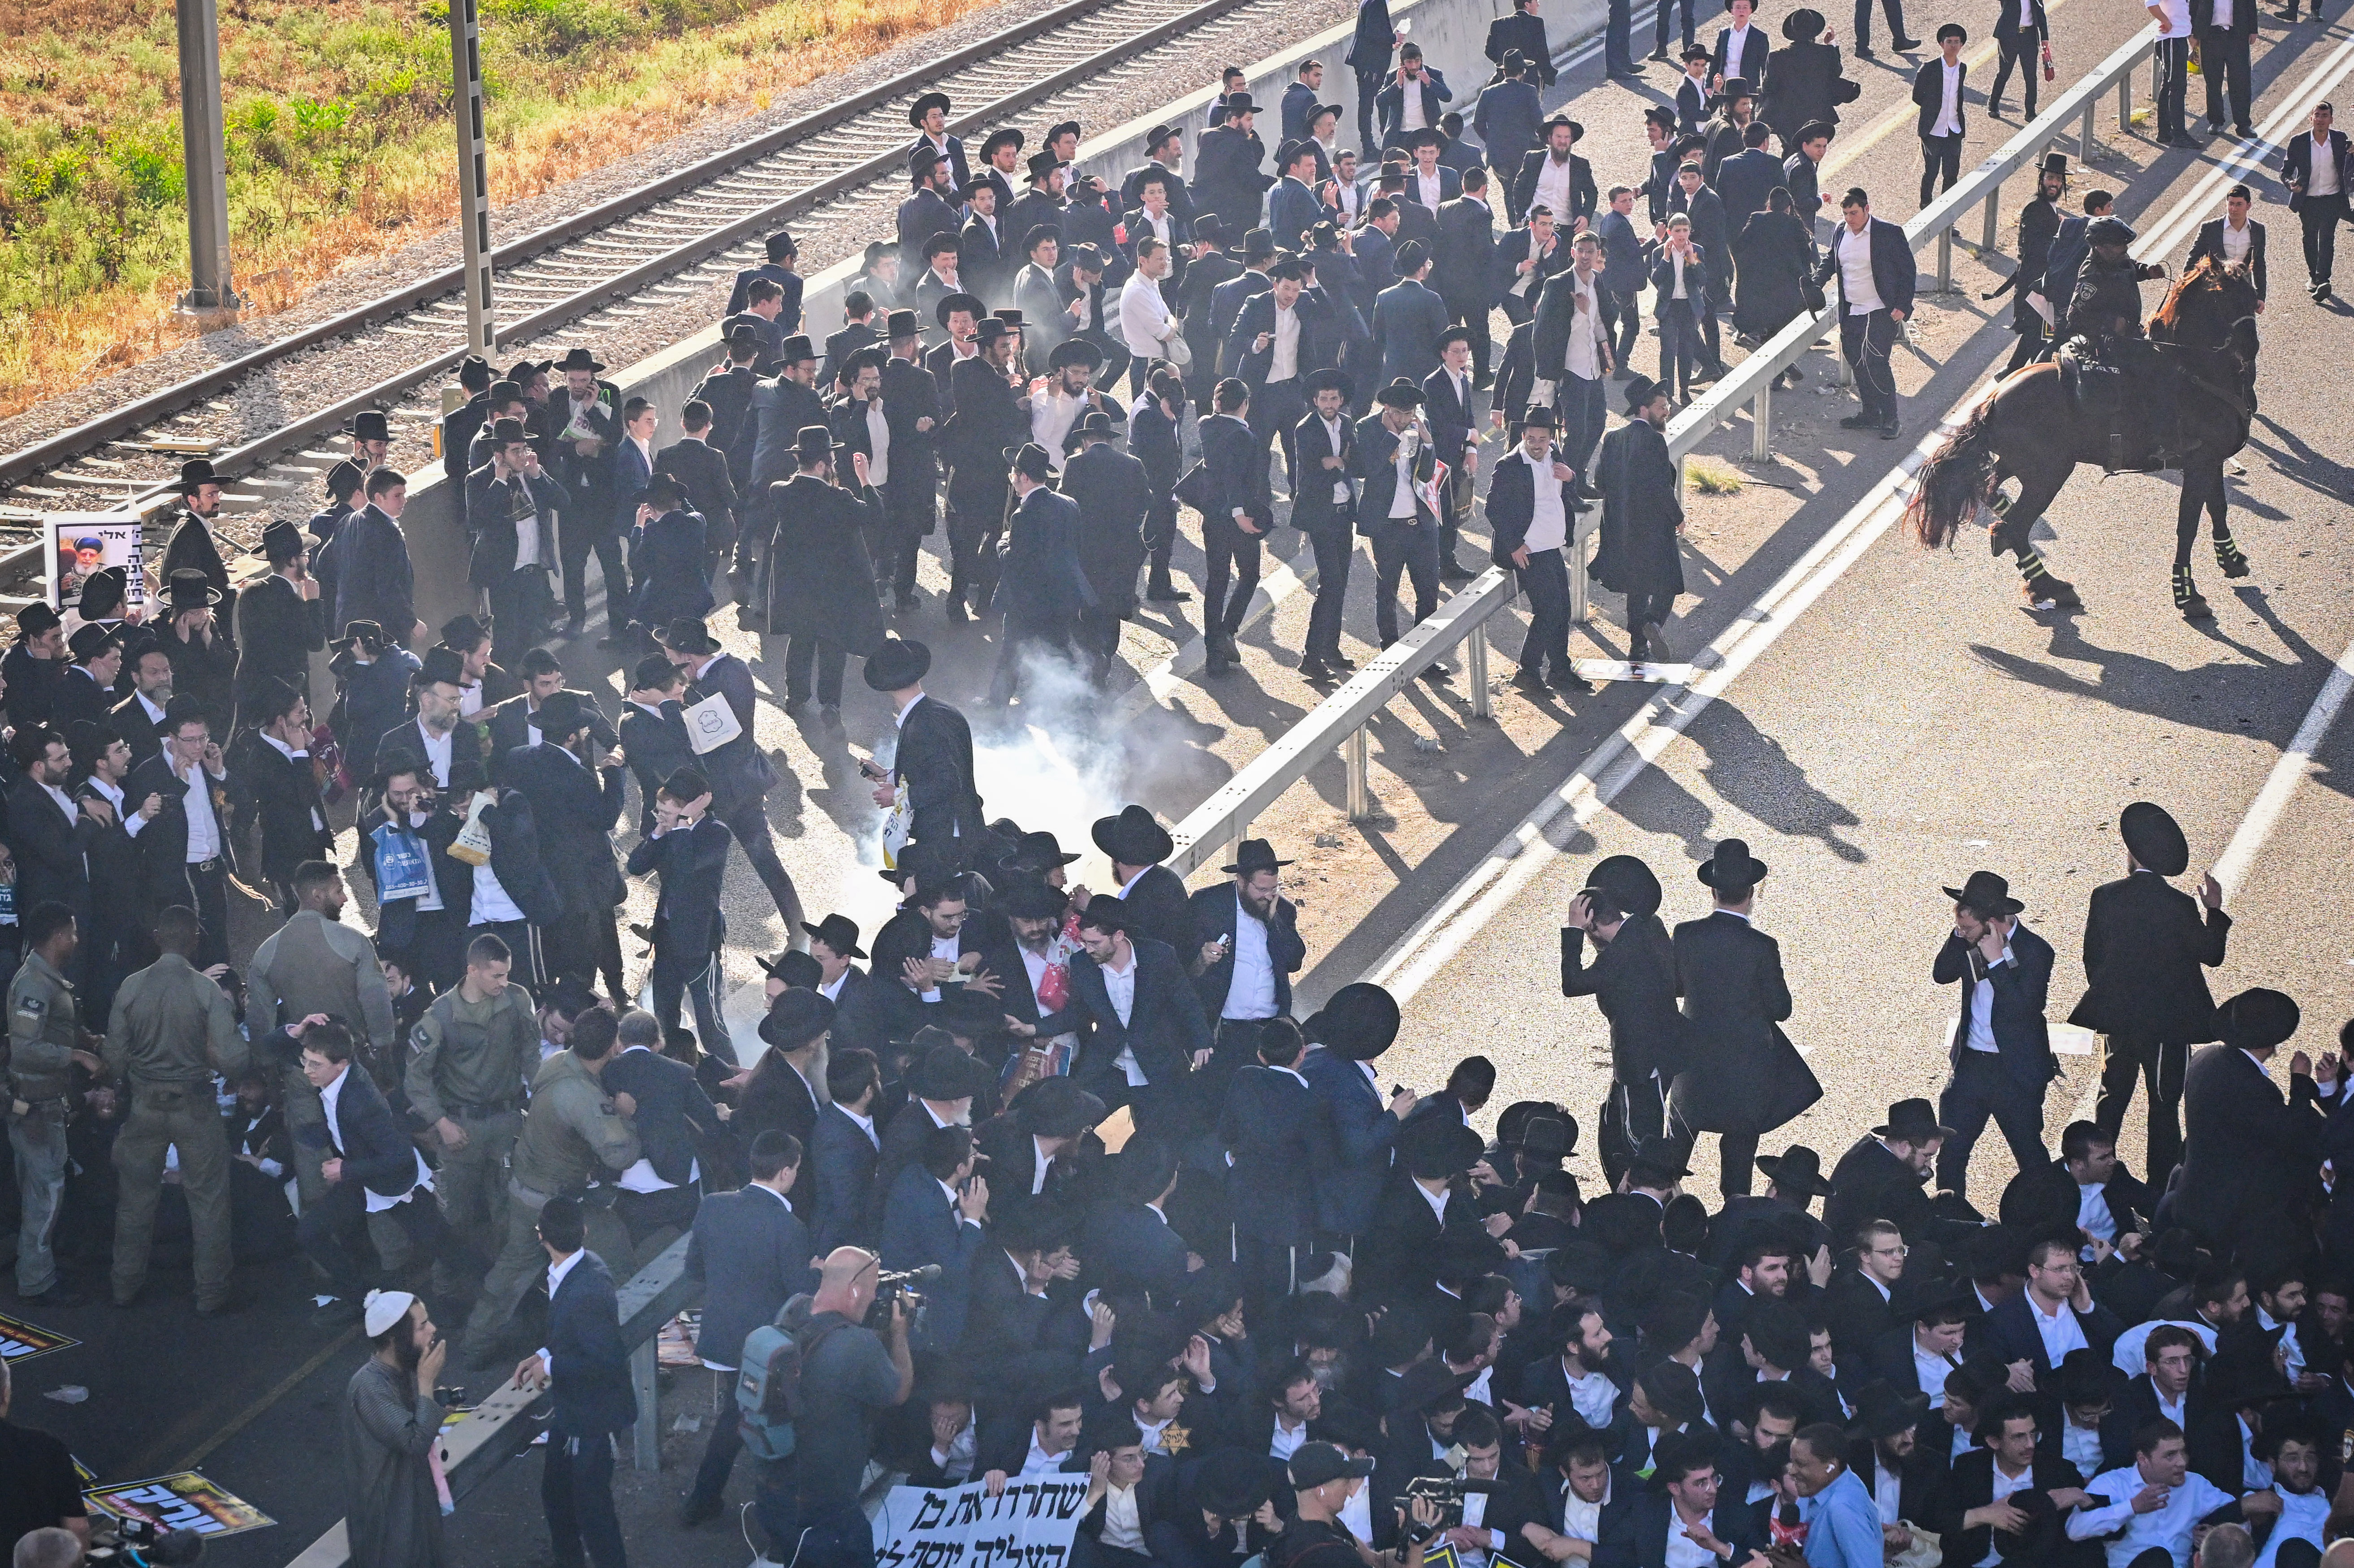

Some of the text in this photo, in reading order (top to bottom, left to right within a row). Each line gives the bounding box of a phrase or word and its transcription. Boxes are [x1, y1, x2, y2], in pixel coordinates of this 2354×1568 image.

[98, 529, 126, 540] אלי
[385, 880, 423, 890] 055-400-30-30
[115, 1485, 227, 1533] עריק
[908, 1482, 1088, 1532] שחררו את בן
[906, 1539, 965, 1568] יוסף
[971, 1533, 1067, 1568] העליה
